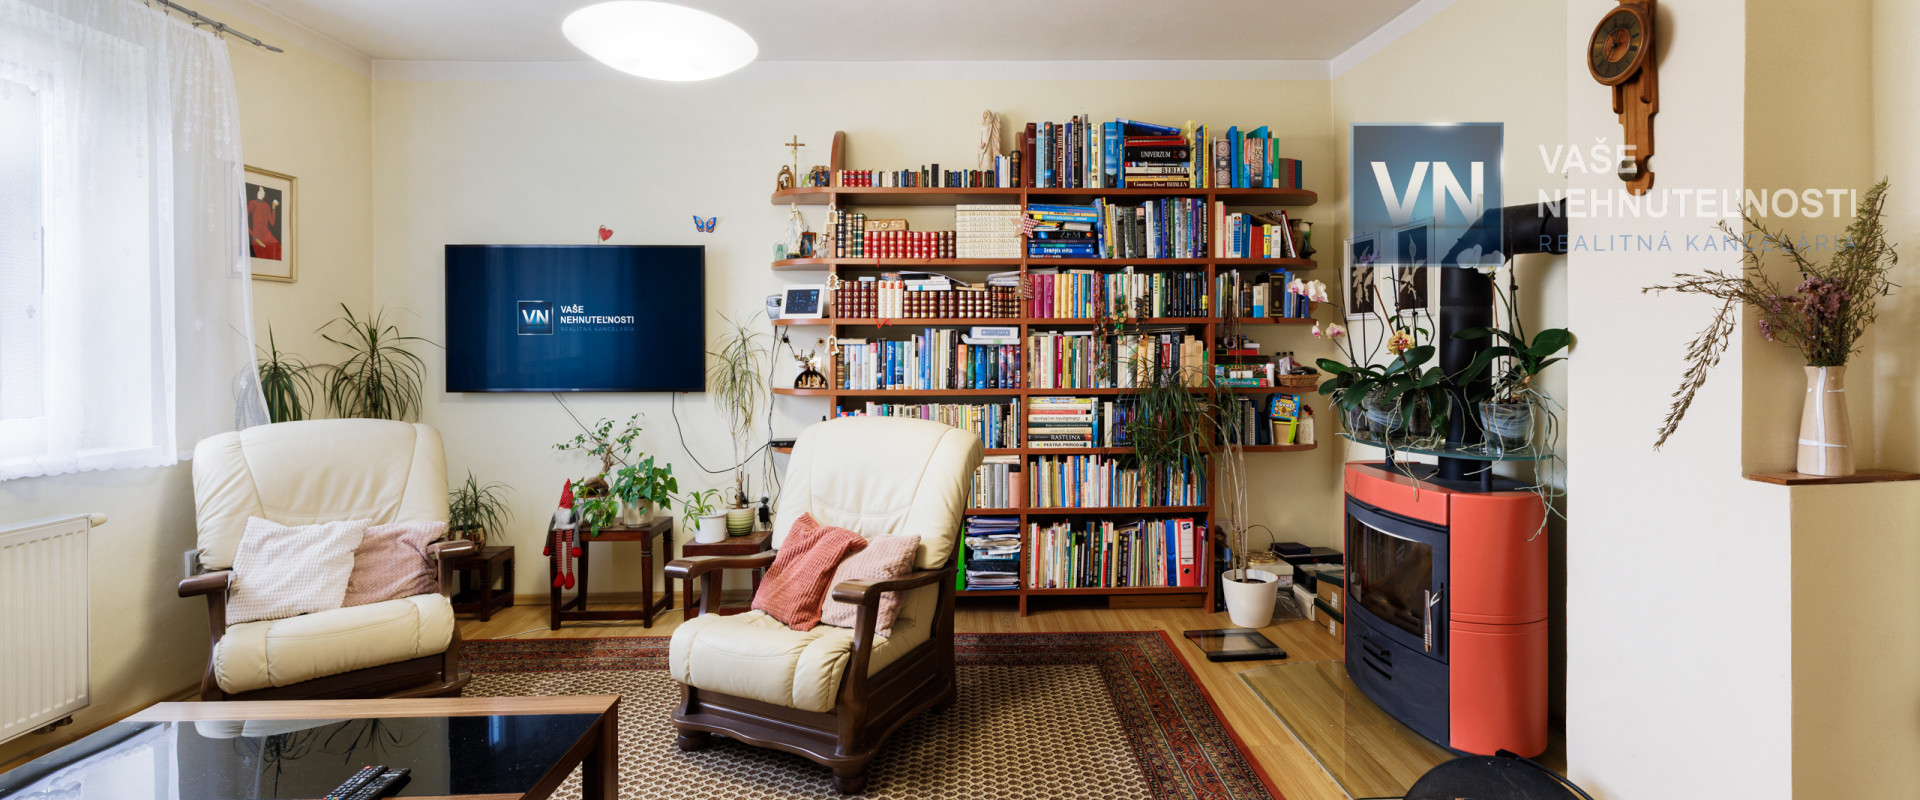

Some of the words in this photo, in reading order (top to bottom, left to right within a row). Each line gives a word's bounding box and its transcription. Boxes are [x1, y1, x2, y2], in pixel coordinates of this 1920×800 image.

[560, 304, 584, 314] VAŠE
[522, 310, 549, 325] VN
[560, 316, 635, 324] NEHNUTEĽNOSTI
